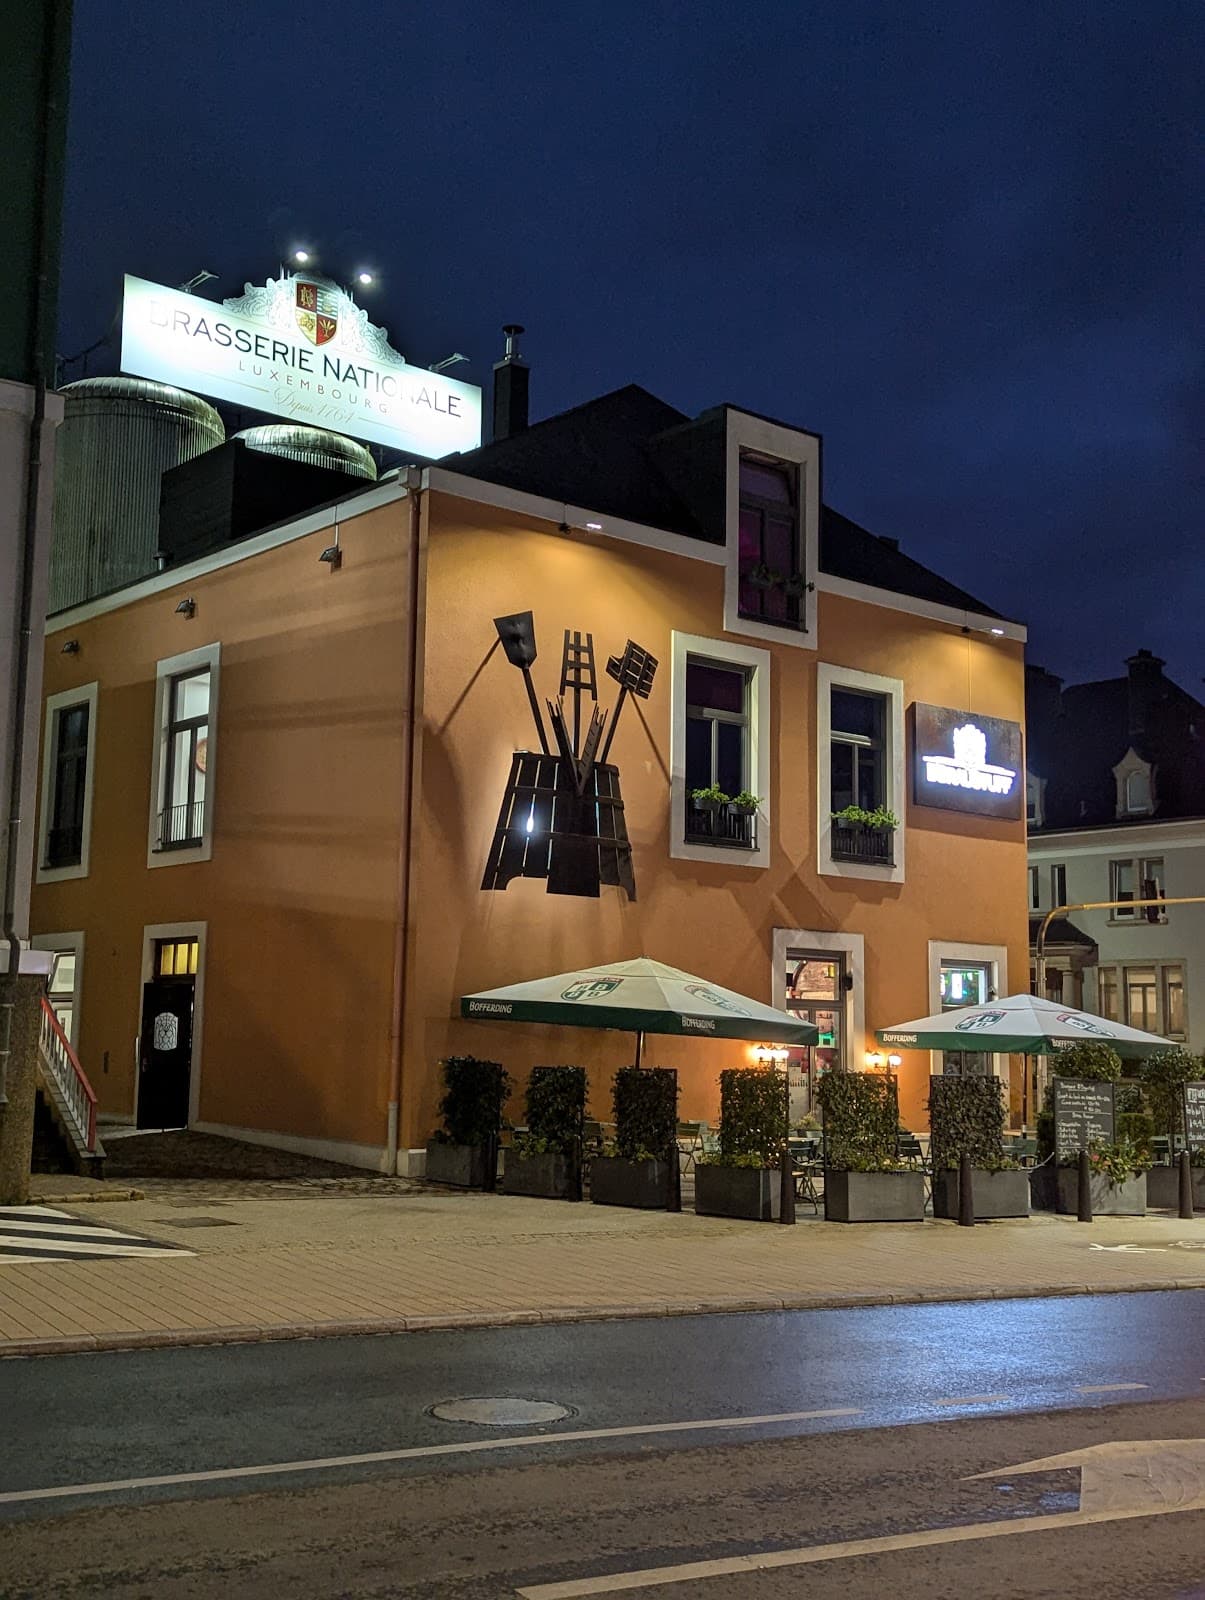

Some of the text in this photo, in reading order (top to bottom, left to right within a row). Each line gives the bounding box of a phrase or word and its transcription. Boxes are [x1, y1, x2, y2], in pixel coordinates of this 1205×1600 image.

[149, 299, 462, 418] BRASSERIE NATIOALE
[239, 361, 389, 414] LUXEMBOURG
[469, 1001, 513, 1014] BOFFERDING
[882, 1033, 918, 1043] BOFFERDING
